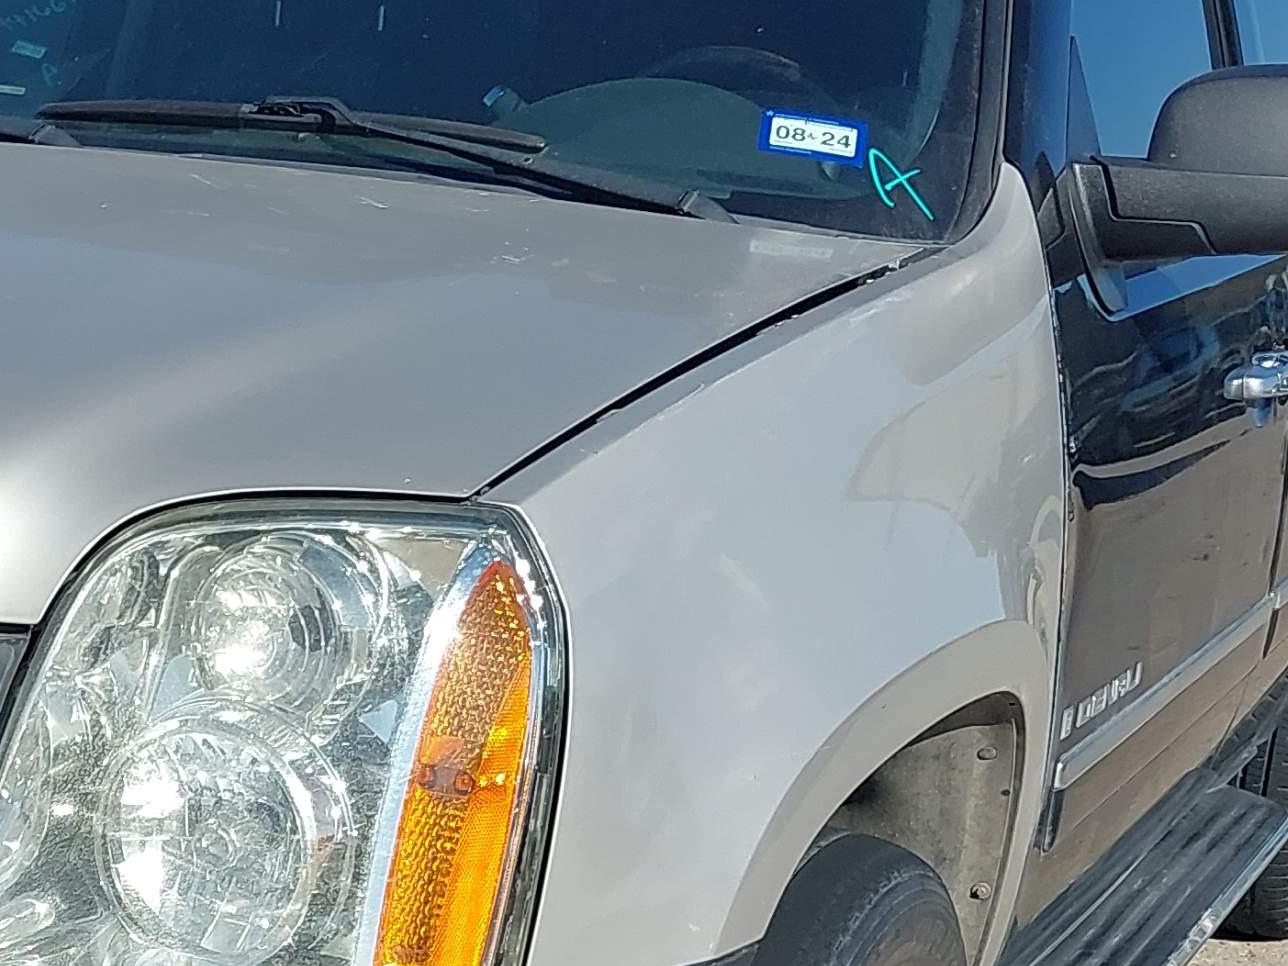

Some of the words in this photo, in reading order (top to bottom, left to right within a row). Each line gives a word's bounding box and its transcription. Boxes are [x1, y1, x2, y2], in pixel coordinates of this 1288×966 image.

[775, 125, 807, 142] 08
[820, 131, 852, 149] 24
[867, 147, 934, 221] A
